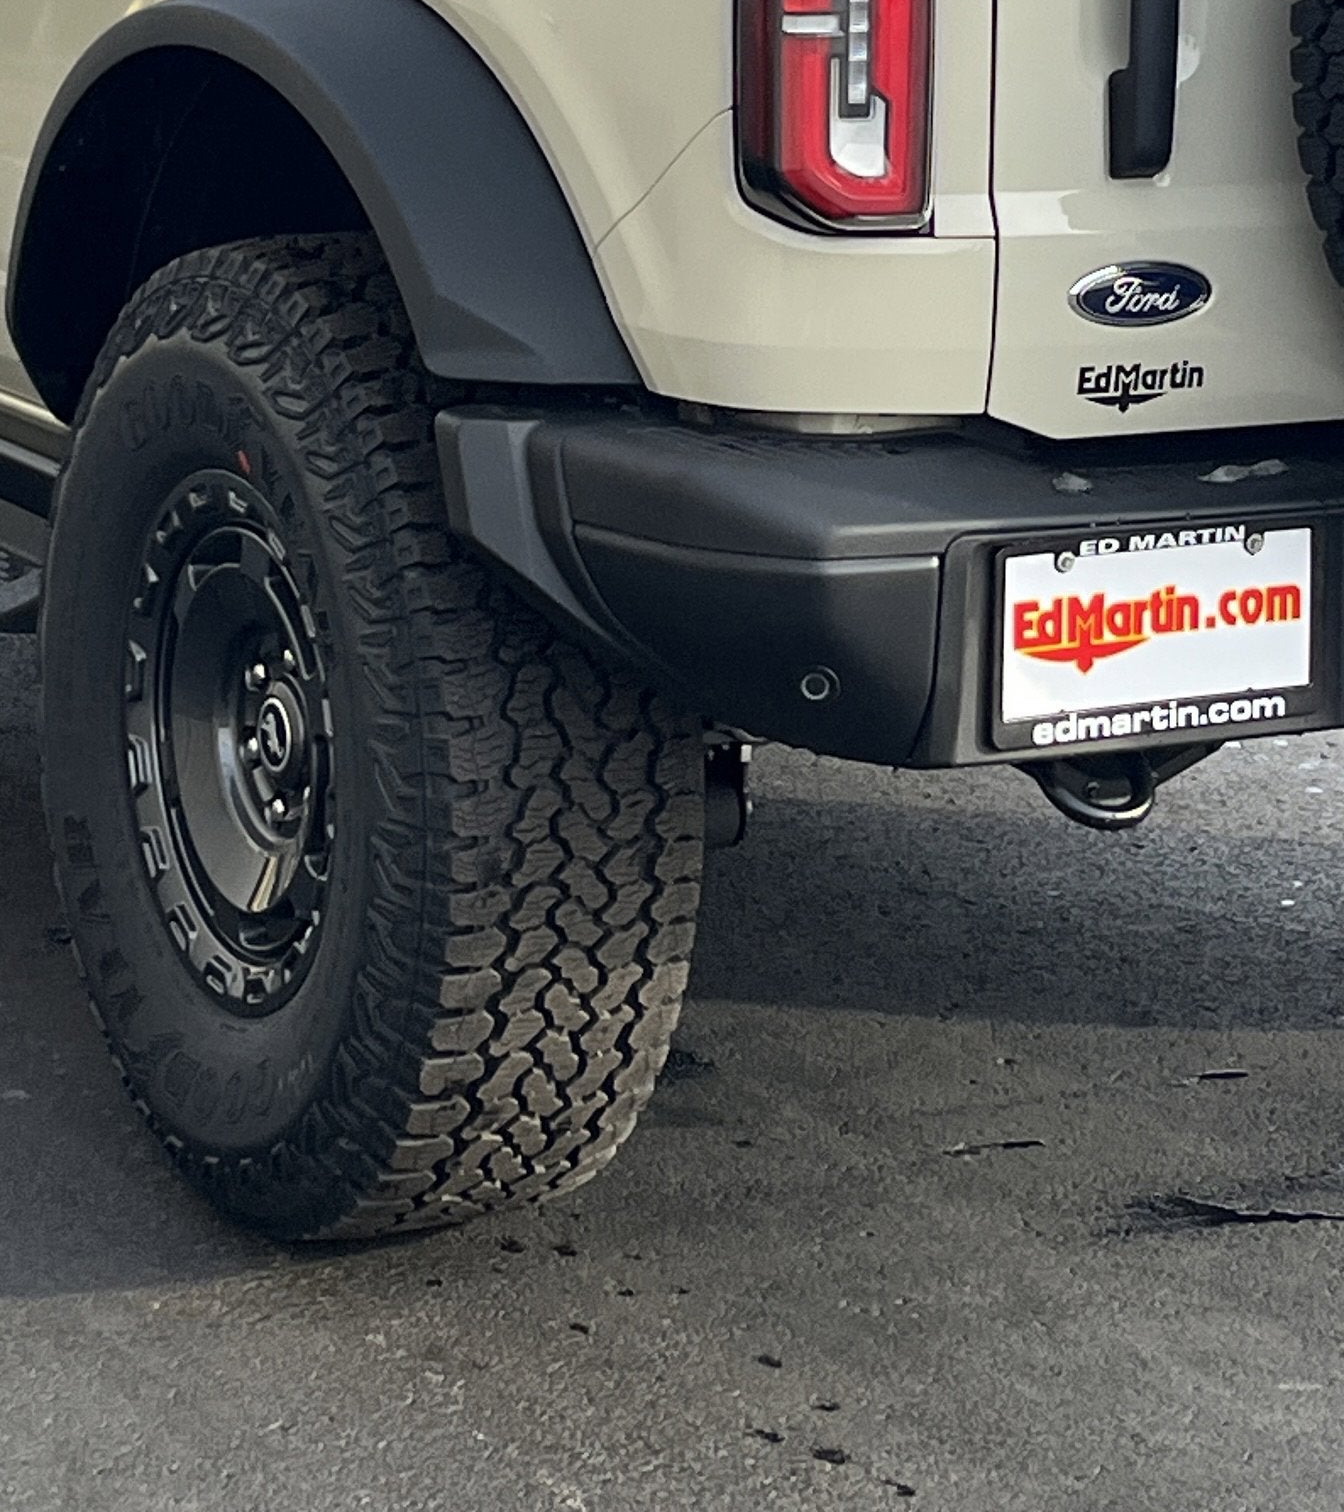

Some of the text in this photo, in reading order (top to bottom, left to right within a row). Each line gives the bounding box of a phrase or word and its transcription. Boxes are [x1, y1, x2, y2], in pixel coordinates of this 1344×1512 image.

[1105, 276, 1180, 314] Ford
[1077, 359, 1204, 396] EdMartin
[1078, 524, 1246, 557] ED MARTIN
[1031, 693, 1287, 746] edmartin.com
